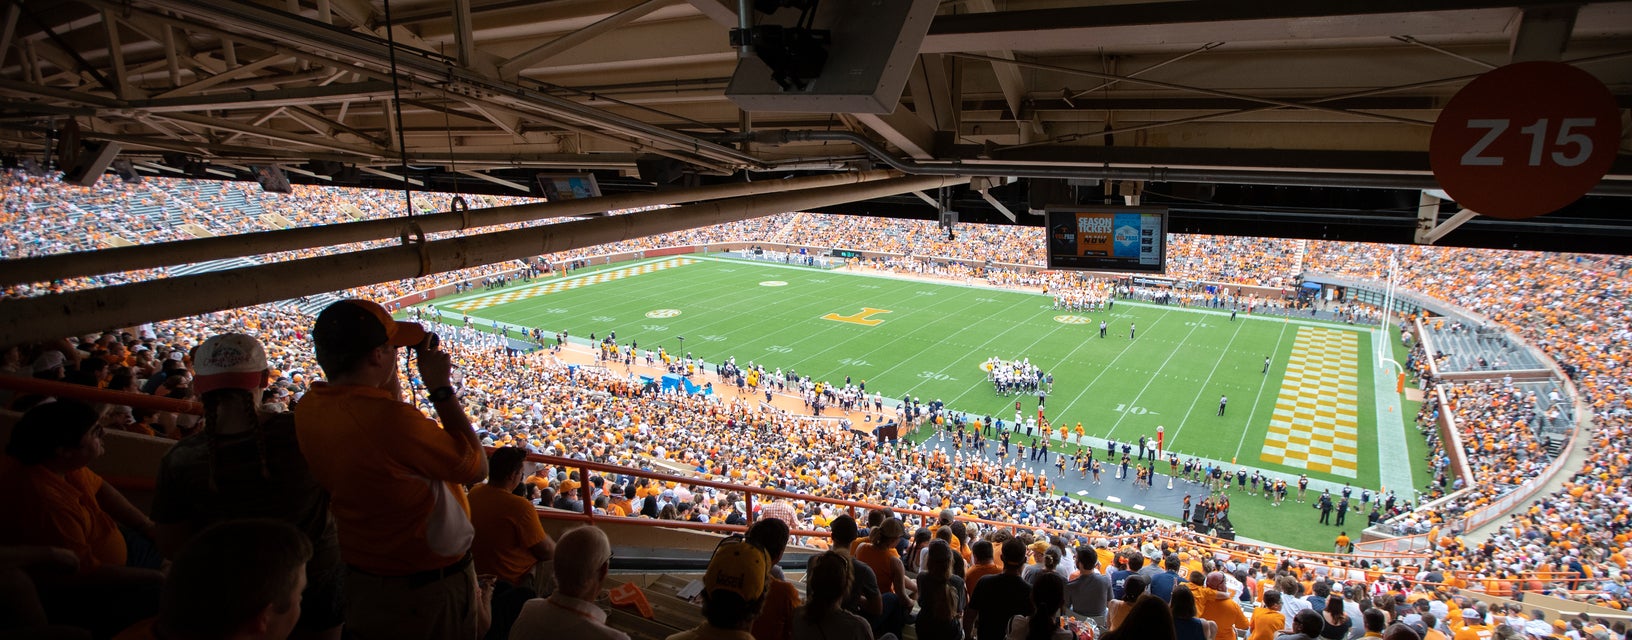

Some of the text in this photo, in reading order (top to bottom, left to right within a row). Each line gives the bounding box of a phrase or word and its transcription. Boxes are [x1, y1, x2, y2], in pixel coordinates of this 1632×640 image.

[1460, 118, 1597, 167] Z 15
[1078, 217, 1112, 227] SEASON
[1079, 224, 1112, 233] TICKETS
[917, 371, 949, 381] 30
[1113, 403, 1147, 415] 10
